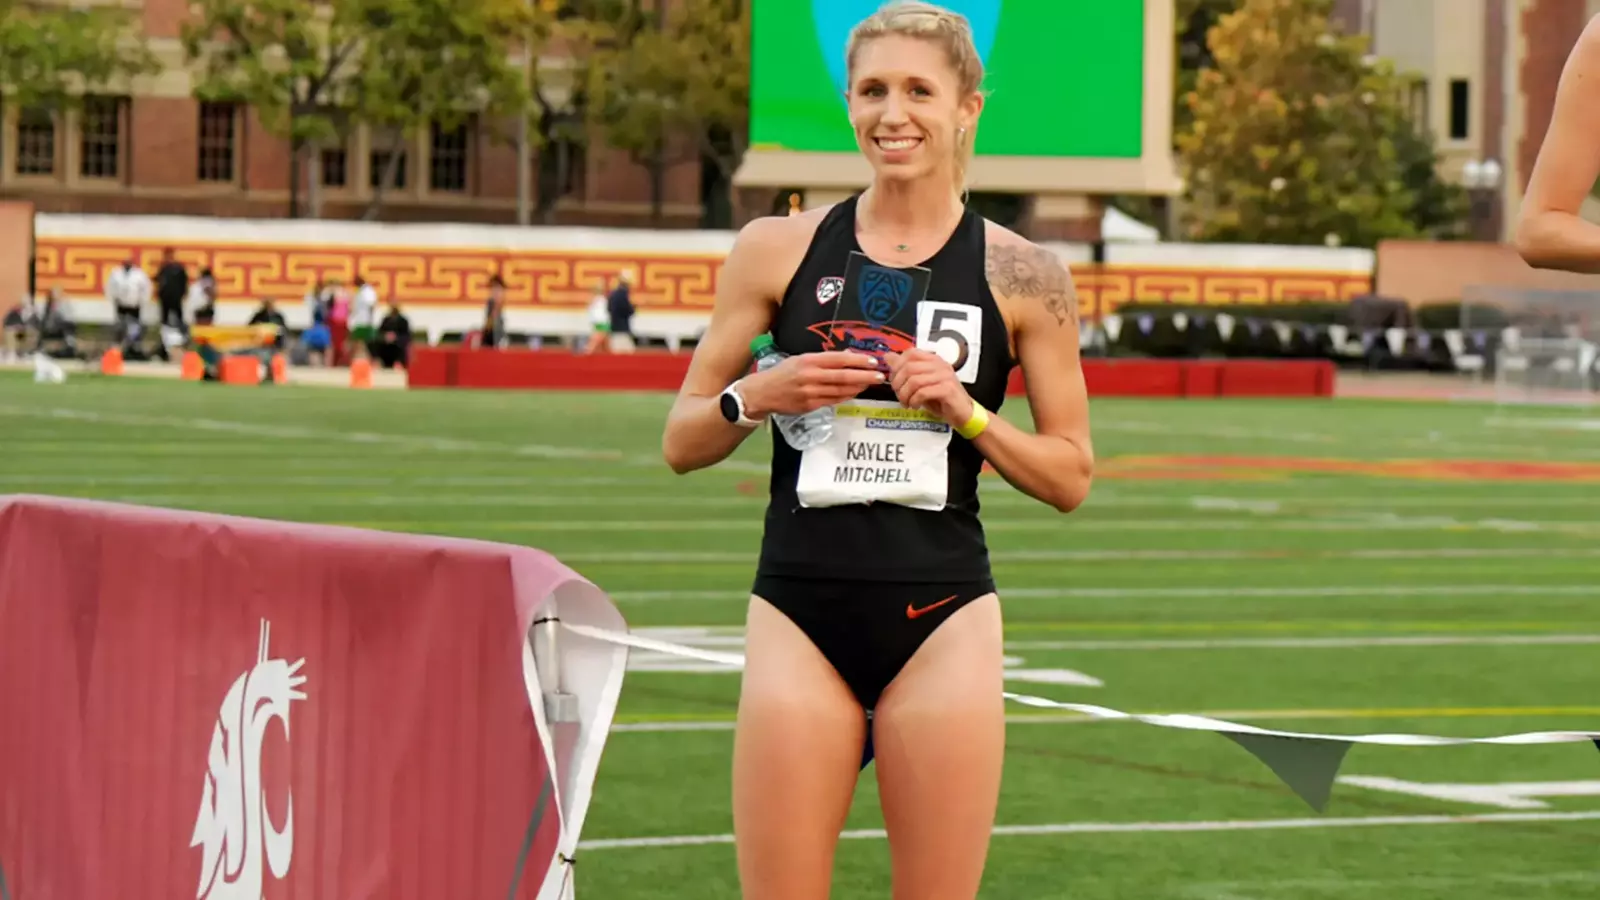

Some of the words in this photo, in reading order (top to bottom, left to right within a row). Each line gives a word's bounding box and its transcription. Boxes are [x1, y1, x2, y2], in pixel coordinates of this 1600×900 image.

[928, 309, 970, 372] 5
[847, 441, 905, 463] KAYLEE
[833, 466, 911, 483] MITCHELL
